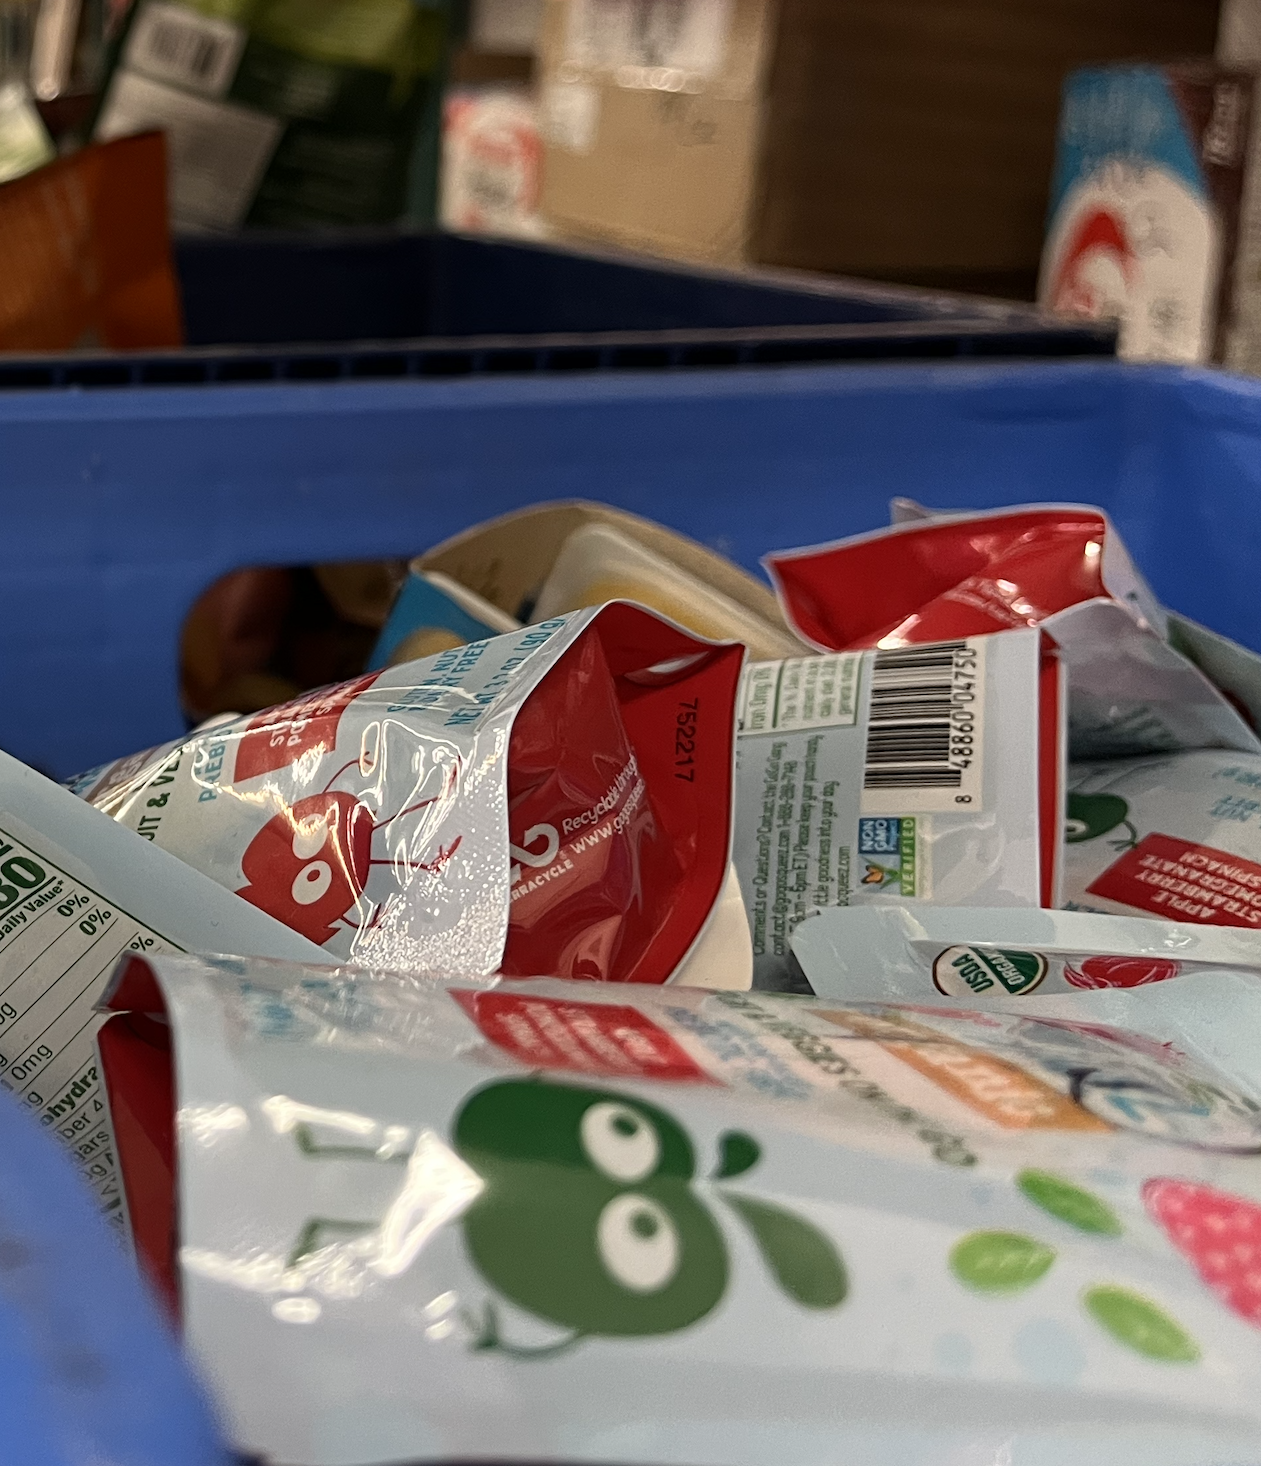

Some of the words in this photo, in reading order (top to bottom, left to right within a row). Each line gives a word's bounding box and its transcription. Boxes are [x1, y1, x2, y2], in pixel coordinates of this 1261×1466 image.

[451, 641, 490, 673] FREE
[674, 697, 699, 783] 752217
[950, 710, 975, 769] 48860
[147, 792, 170, 808] &
[562, 787, 620, 834] Recyclable
[954, 794, 973, 804] 8
[137, 815, 161, 841] UIT
[861, 819, 874, 851] NON
[874, 819, 887, 850] GMO
[903, 819, 914, 893] VERIFIED
[1134, 869, 1261, 923] STRAWBERRY
[1139, 854, 1261, 911] OMEGRANATE
[57, 892, 90, 918] 0%
[1151, 889, 1216, 918] APPLE
[80, 907, 112, 936] 0%
[752, 900, 766, 955] Comments
[951, 954, 994, 992] USDA
[12, 1044, 53, 1081] 0mg
